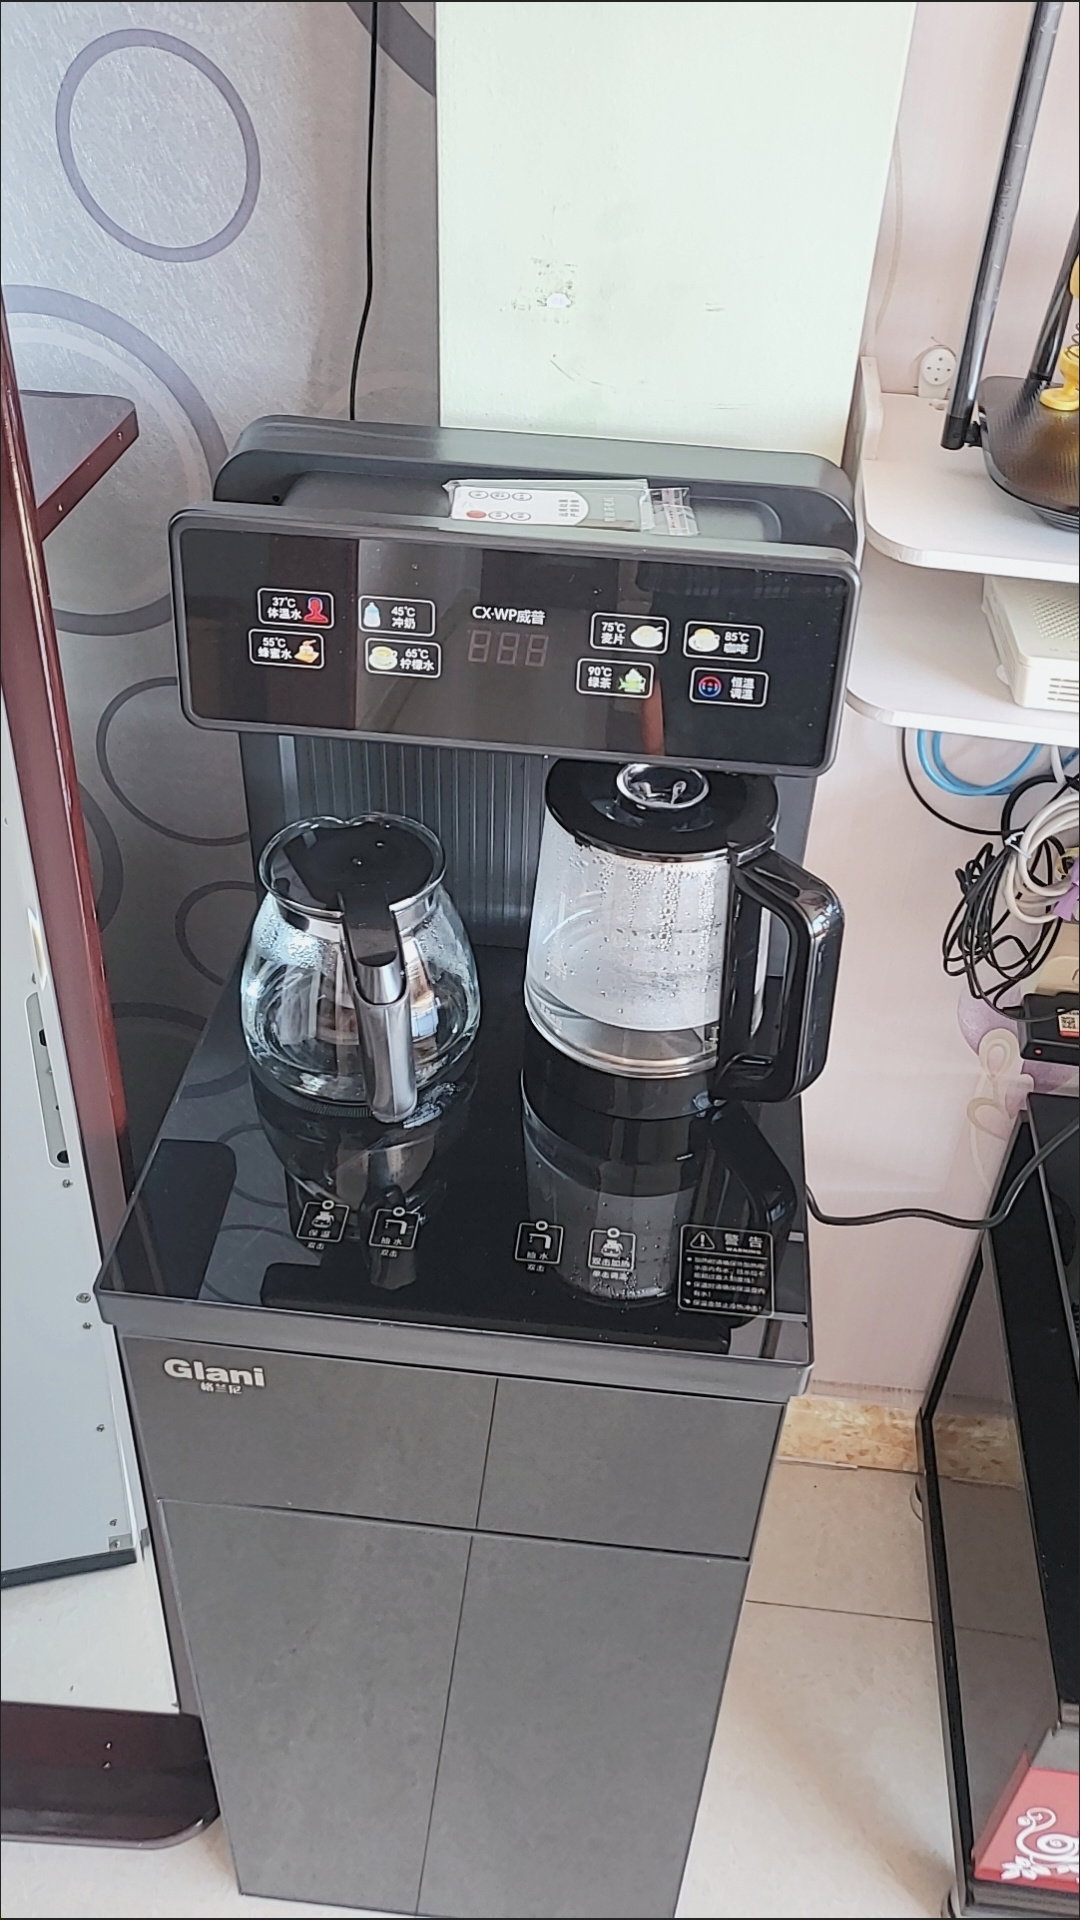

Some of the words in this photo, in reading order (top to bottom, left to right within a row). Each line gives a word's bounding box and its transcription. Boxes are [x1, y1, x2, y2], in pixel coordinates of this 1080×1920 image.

[267, 607, 302, 620] 体温水
[391, 617, 416, 629] 冲奶
[601, 632, 625, 645] 麦片
[258, 647, 292, 660] 蜂蜜水
[400, 658, 435, 671] 柠檬水
[587, 676, 612, 689] 绿茶
[731, 676, 755, 689] 恒温
[163, 1358, 265, 1387] Glani
